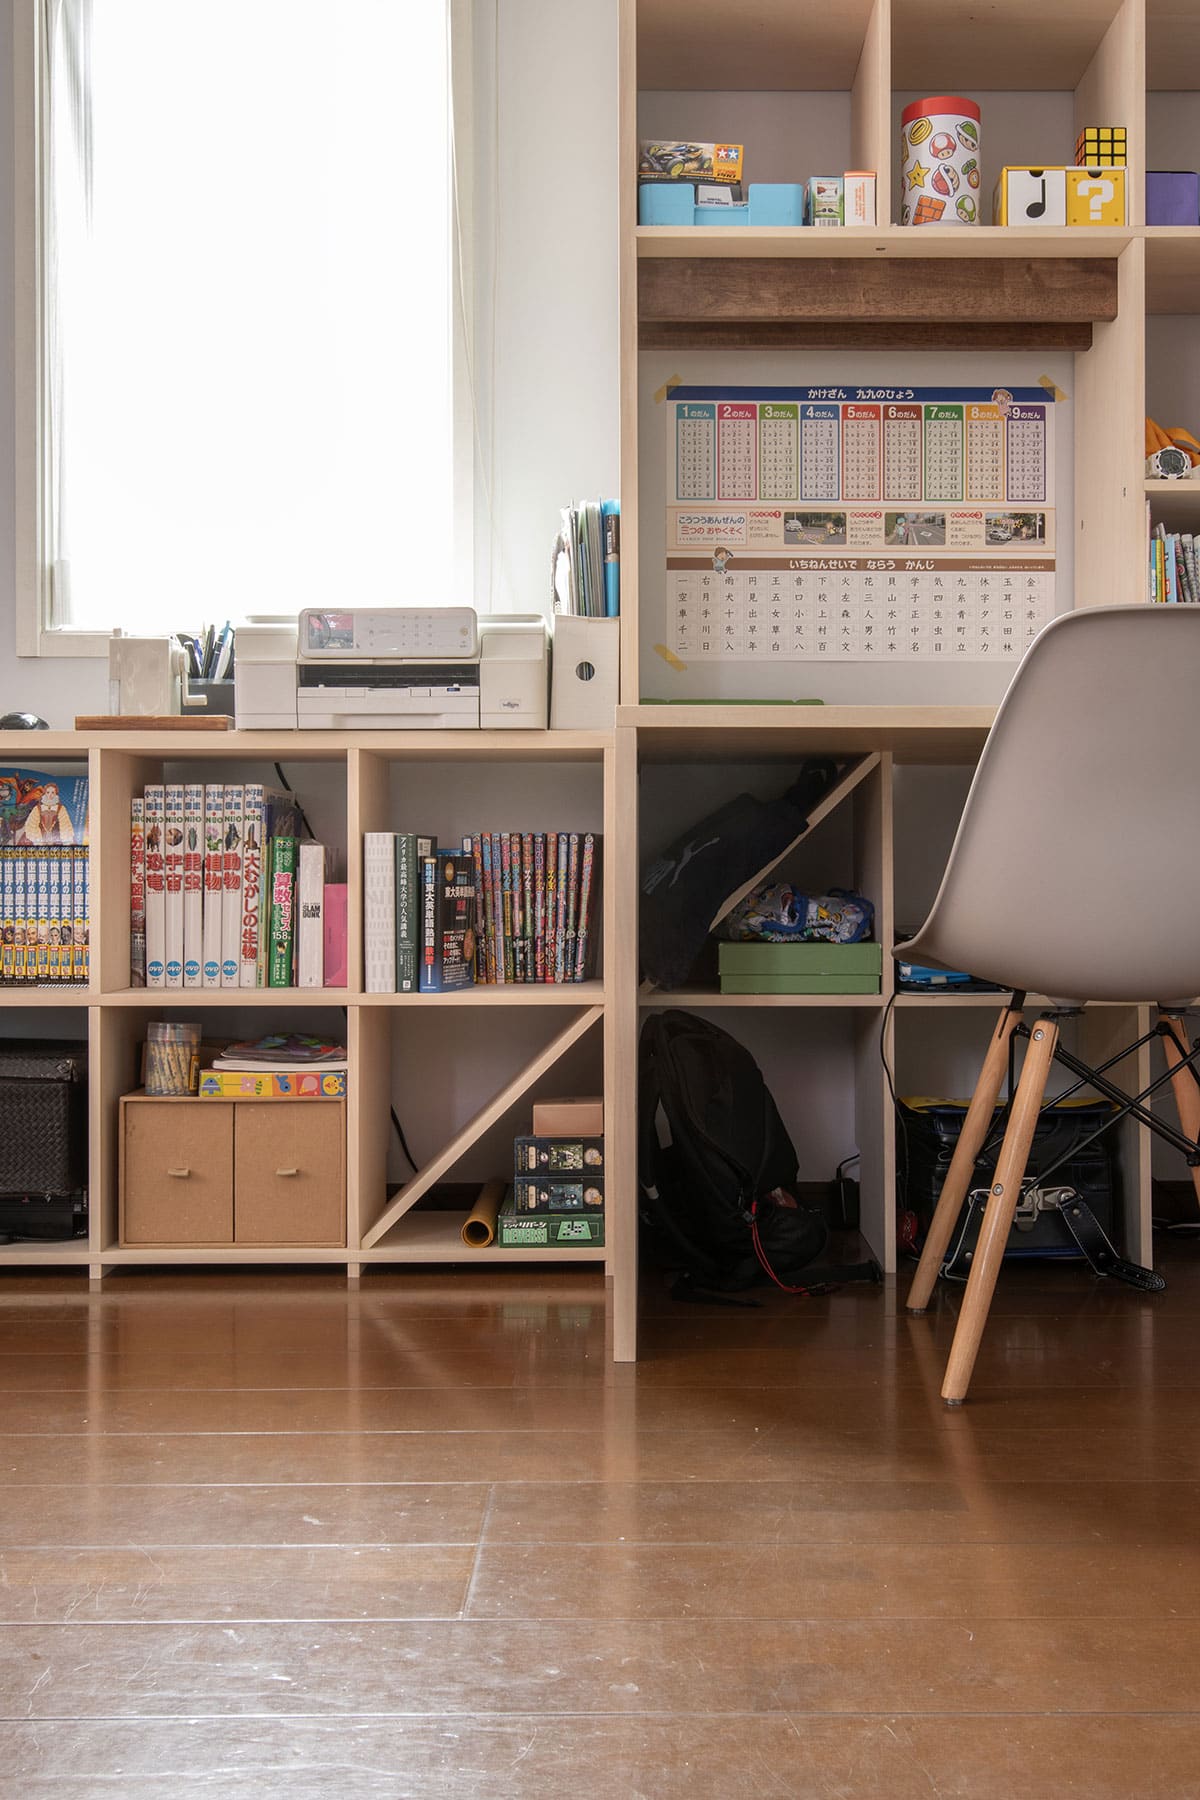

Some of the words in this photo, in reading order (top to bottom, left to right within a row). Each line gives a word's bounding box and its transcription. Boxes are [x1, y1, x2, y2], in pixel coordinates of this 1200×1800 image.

[808, 388, 846, 399] かけざん
[856, 388, 914, 400] 九九のひょう
[682, 406, 710, 418] 1のだん
[723, 406, 751, 418] 2のだん
[764, 406, 792, 418] 3のだん
[806, 406, 834, 418] 4のだん
[847, 406, 876, 418] 5のだん
[888, 407, 916, 418] 6のだん
[930, 407, 958, 418] 7のだん
[1012, 407, 1040, 418] 9のだん
[678, 516, 744, 524] こうつうあんぜんの
[681, 526, 704, 535] 三つの
[707, 526, 743, 535] おやくそく
[789, 560, 857, 570] いちねんせいで
[866, 560, 896, 570] ならう
[905, 560, 934, 570] かんじ
[146, 853, 164, 891] 恐竜
[166, 853, 182, 891] 宇宙
[184, 853, 201, 891] 昆虫
[205, 853, 222, 891] 植物
[224, 853, 240, 890] 動物
[242, 854, 260, 959] 大むかしの生物
